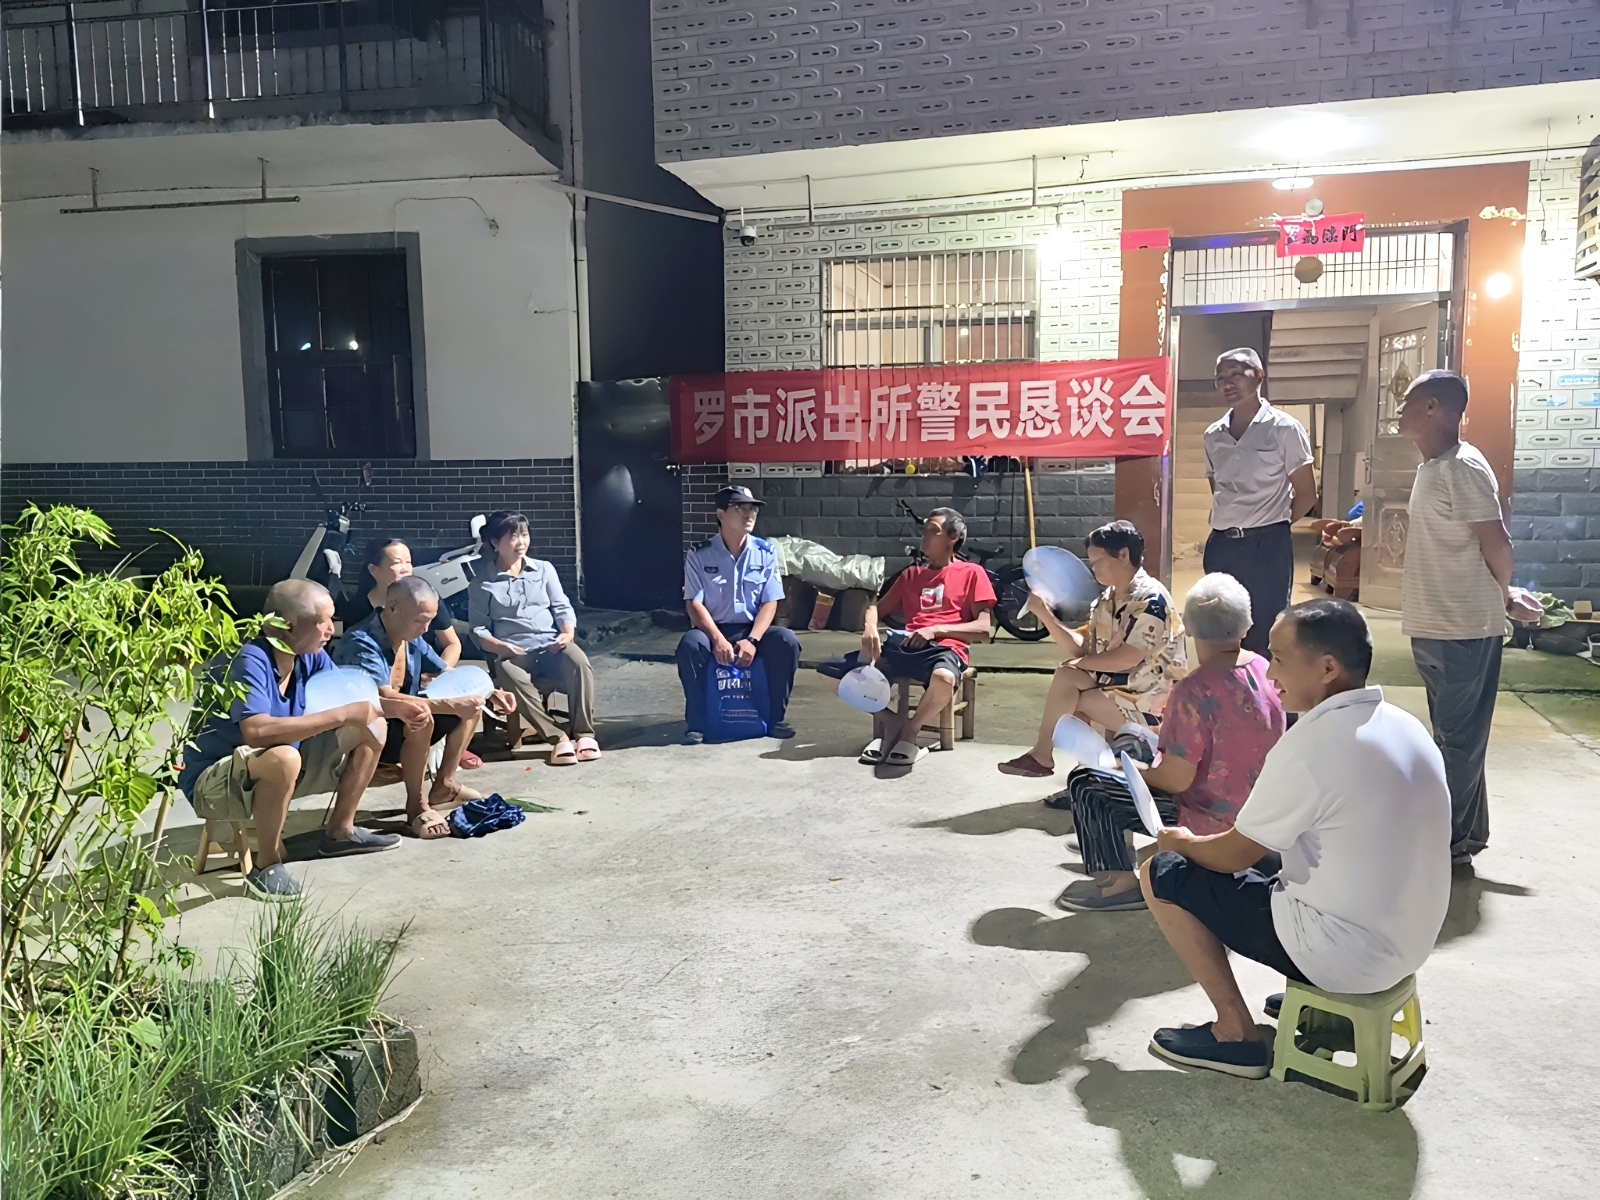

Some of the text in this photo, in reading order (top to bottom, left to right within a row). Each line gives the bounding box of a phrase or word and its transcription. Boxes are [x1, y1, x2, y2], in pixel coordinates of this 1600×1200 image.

[692, 374, 1166, 445] 罗市派出所警民恳谈会
